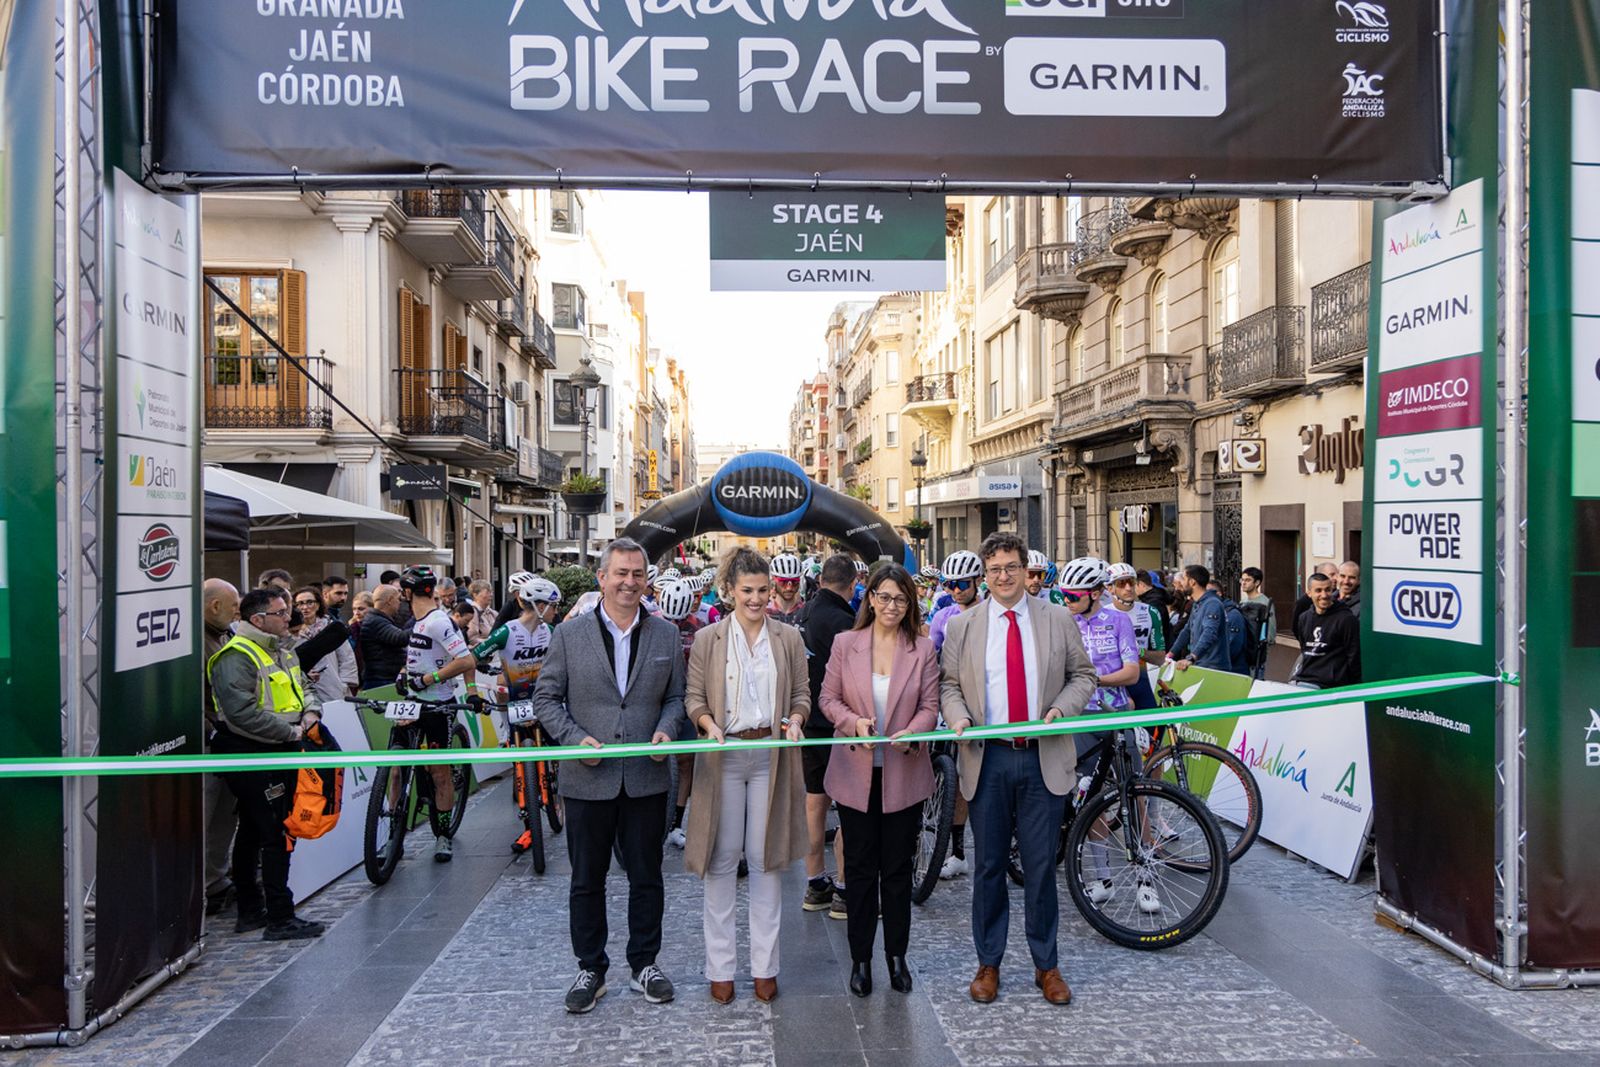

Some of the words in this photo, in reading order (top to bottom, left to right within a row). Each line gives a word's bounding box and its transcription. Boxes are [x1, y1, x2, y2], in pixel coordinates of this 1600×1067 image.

[289, 22, 372, 62] JAÉN
[1335, 33, 1390, 42] CICLISMO
[509, 34, 710, 112] BIKE
[738, 37, 982, 115] RACE
[985, 46, 1002, 56] BY
[1030, 63, 1202, 91] GARMIN
[257, 65, 405, 107] CÓRDOBA
[773, 204, 859, 224] STAGE
[865, 204, 884, 224] 4
[795, 229, 863, 252] JAÉN
[787, 269, 871, 282] GARMIN
[1386, 294, 1469, 334] GARMIN
[1403, 378, 1469, 405] IMDECO
[146, 457, 177, 489] Jaén
[720, 484, 800, 500] GARMIN
[1389, 513, 1461, 535] POWER
[1420, 536, 1461, 559] ADE
[1398, 588, 1454, 621] CRUZ
[136, 608, 181, 648] SER
[393, 703, 415, 716] 13-2
[1385, 704, 1471, 734] andaluciabikerace.com
[1234, 729, 1309, 793] Andalucía
